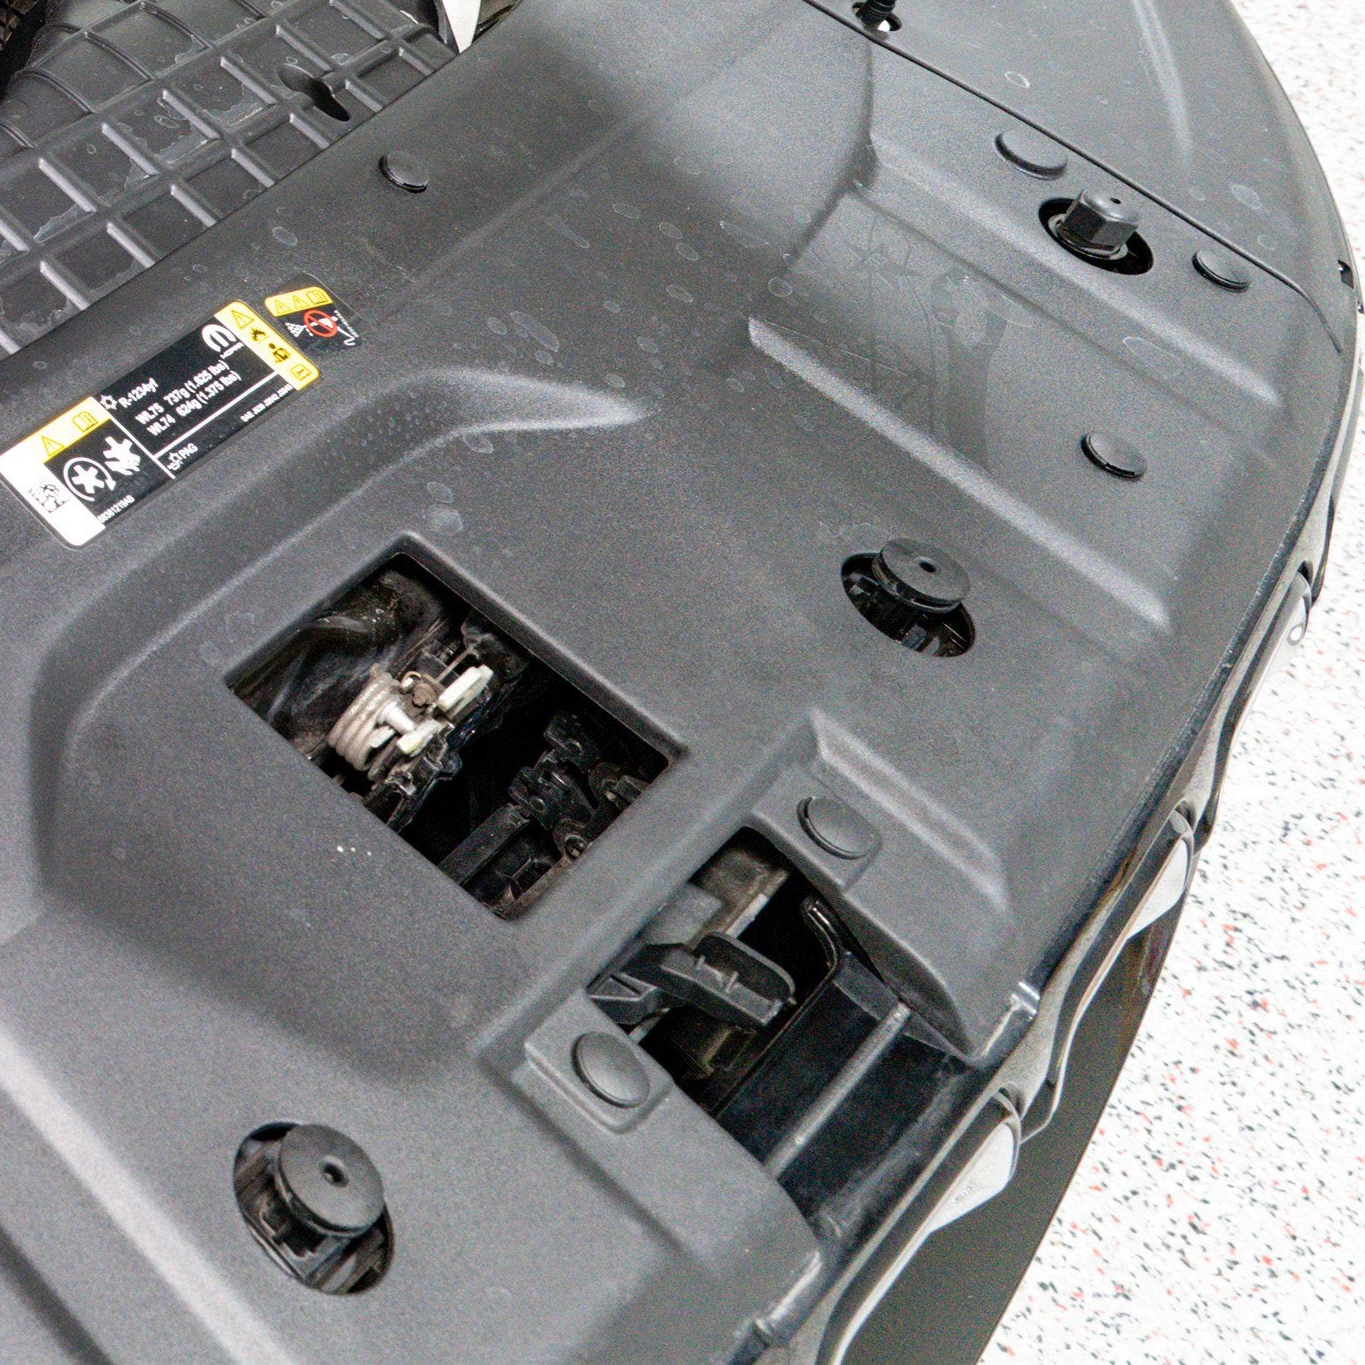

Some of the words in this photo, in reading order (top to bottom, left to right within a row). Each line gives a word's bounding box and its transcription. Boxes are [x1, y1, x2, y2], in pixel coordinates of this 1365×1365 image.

[117, 377, 159, 409] R-1234yf
[134, 402, 165, 425] WL75
[163, 387, 191, 406] 737g
[207, 359, 230, 376] lbs)
[146, 413, 176, 436] WL74
[175, 398, 202, 418] 624g
[196, 380, 225, 405] (1.375
[219, 370, 242, 387] lbs)
[178, 442, 199, 460] PAG
